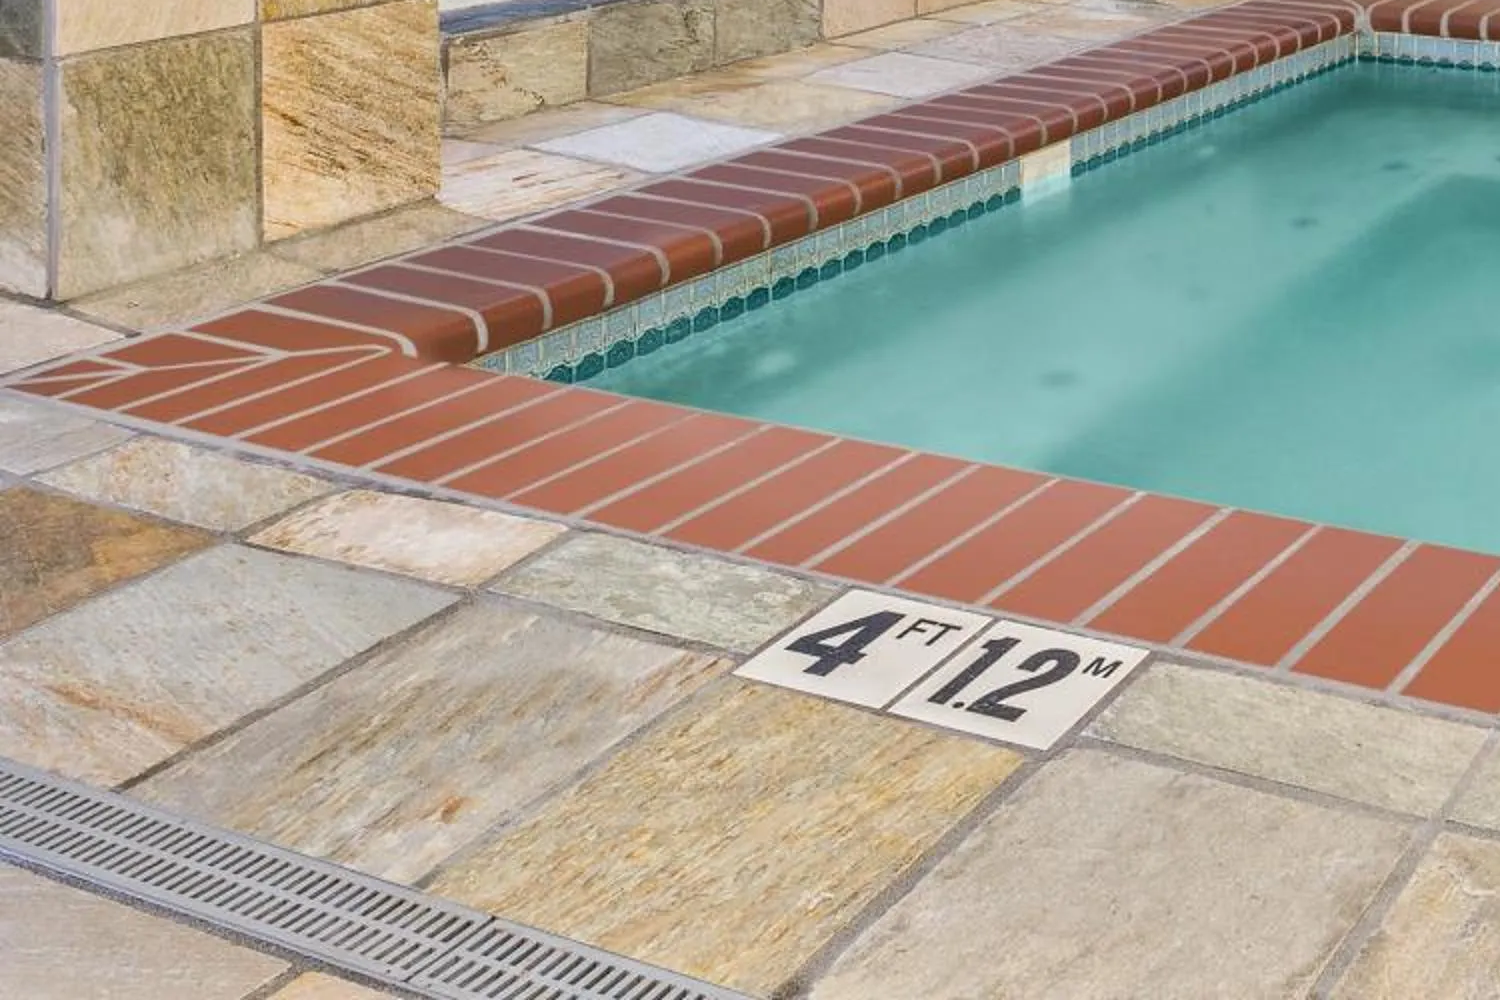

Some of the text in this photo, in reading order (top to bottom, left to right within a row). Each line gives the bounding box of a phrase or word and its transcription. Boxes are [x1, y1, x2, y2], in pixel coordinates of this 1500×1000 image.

[784, 611, 962, 677] 4 FT
[1082, 657, 1123, 679] M
